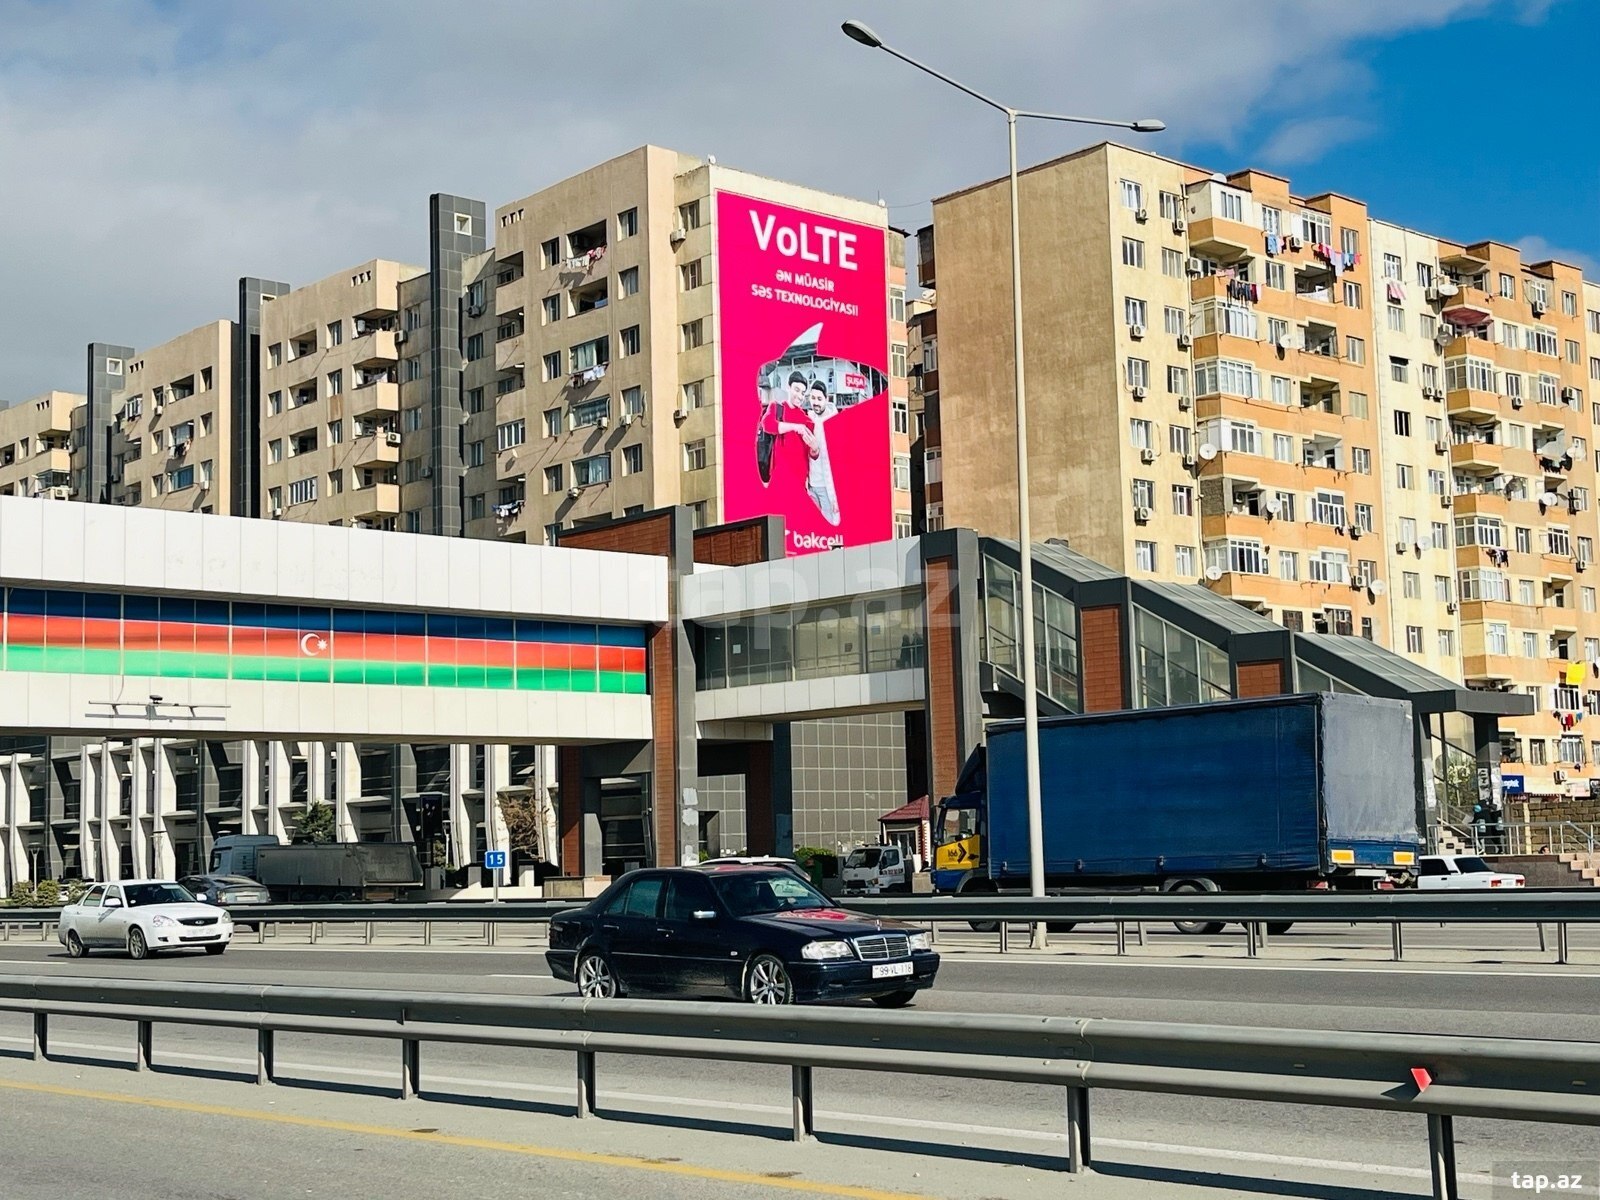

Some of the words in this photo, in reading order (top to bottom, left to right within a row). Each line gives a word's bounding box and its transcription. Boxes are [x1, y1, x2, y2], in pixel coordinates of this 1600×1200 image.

[749, 210, 858, 271] VoLTE
[776, 270, 792, 283] ƏN
[795, 273, 834, 292] MÜASİR
[751, 284, 773, 299] SƏS
[774, 288, 858, 316] TEXNOLOGİYASI!
[793, 530, 844, 550] bakcell
[489, 854, 504, 865] 15
